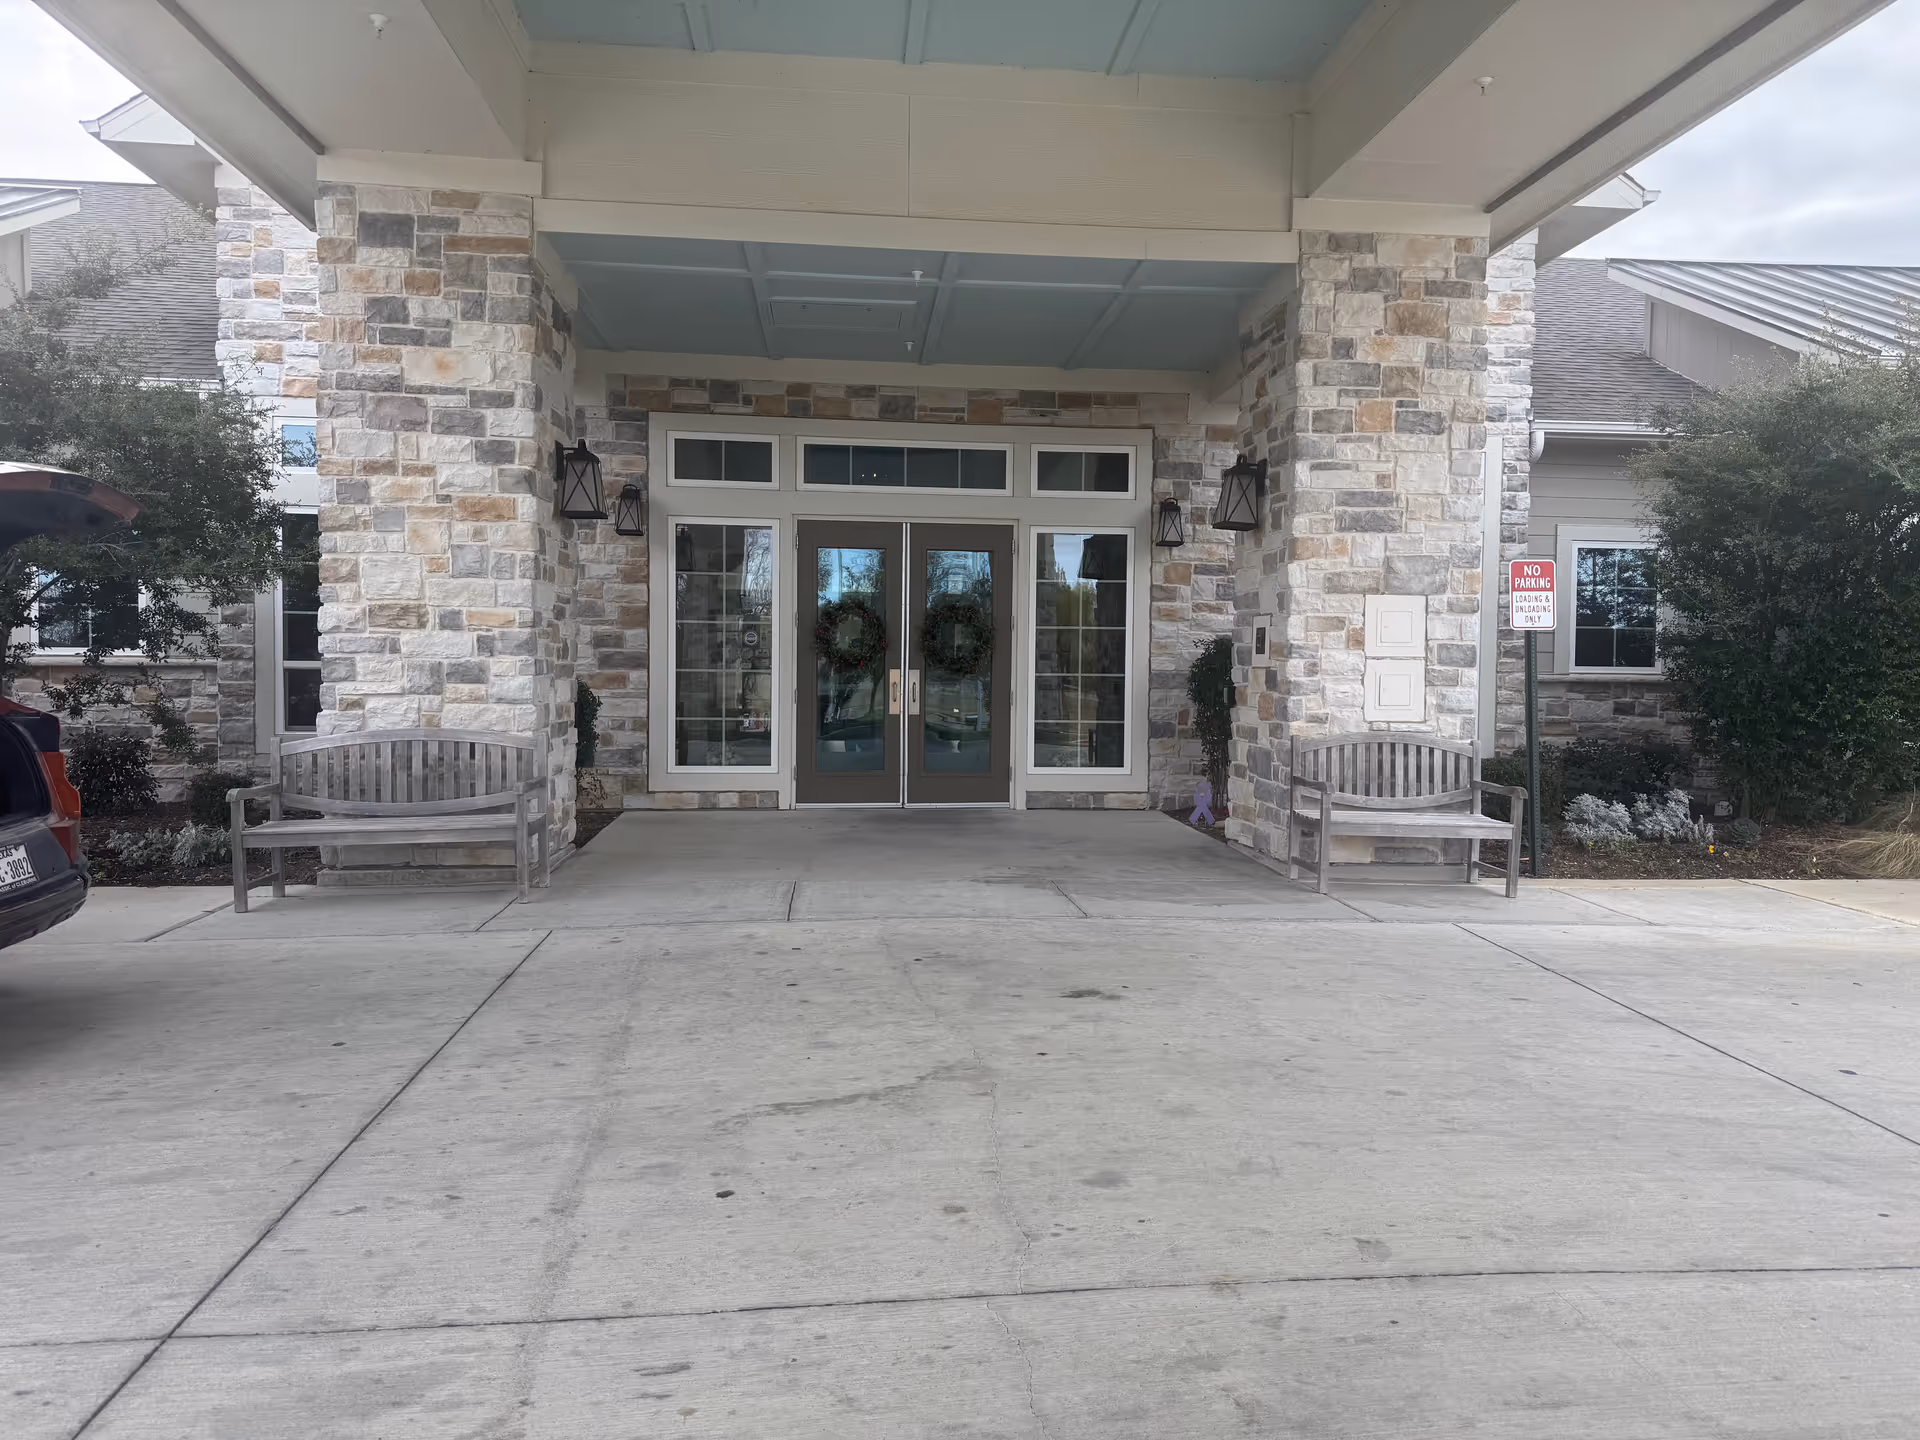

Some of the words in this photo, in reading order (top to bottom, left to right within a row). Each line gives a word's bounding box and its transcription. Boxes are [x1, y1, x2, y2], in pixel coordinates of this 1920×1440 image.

[1524, 565, 1540, 576] NO
[1515, 577, 1550, 588] PARKING
[1515, 595, 1543, 603] LOADING
[1545, 595, 1550, 603] &
[1515, 605, 1551, 613] UNLOADING
[1525, 615, 1541, 623] ONLY
